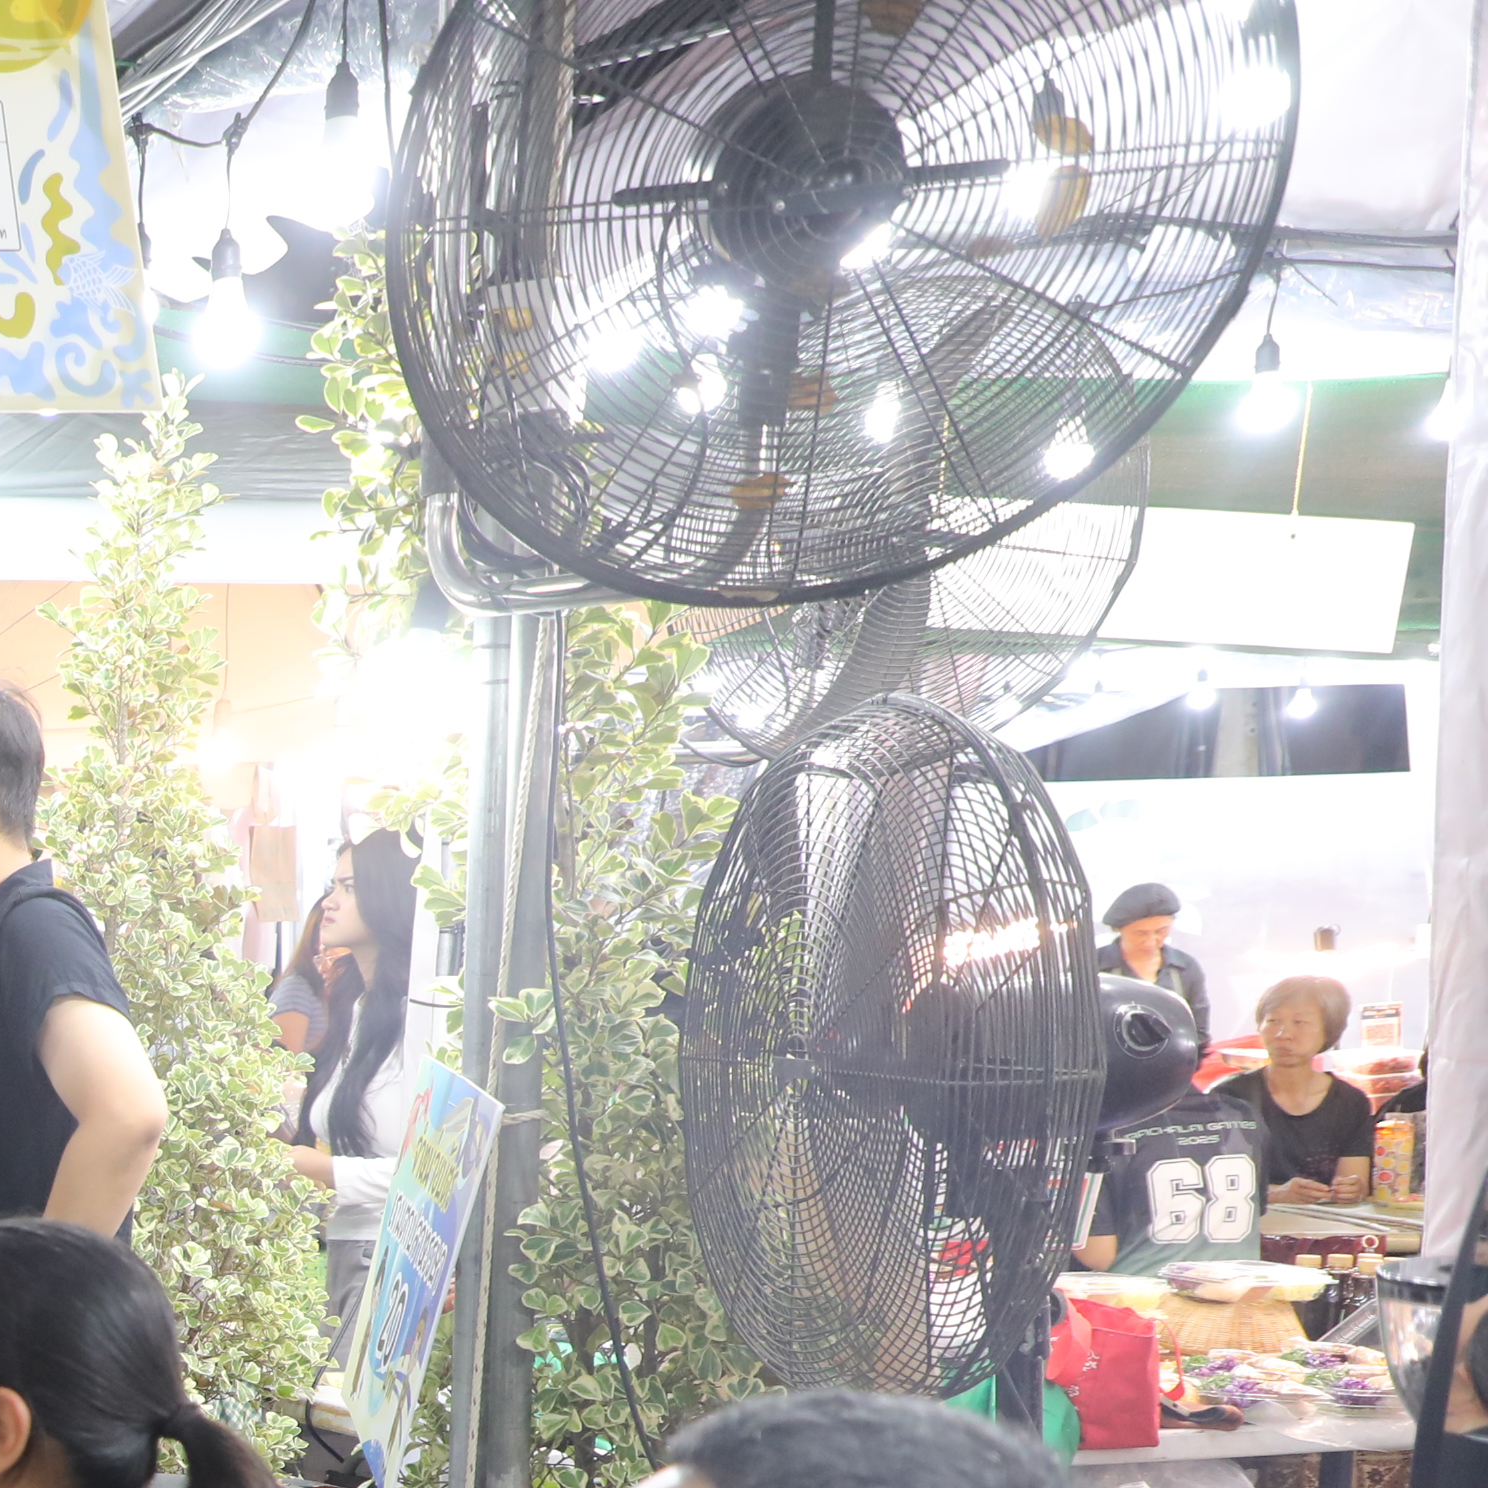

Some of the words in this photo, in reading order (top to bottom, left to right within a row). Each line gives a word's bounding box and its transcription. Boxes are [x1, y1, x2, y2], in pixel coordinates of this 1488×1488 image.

[1177, 1134, 1220, 1146] 2025
[1206, 1120, 1257, 1130] GAMES
[1146, 1153, 1256, 1244] 68
[375, 1271, 411, 1374] 20
